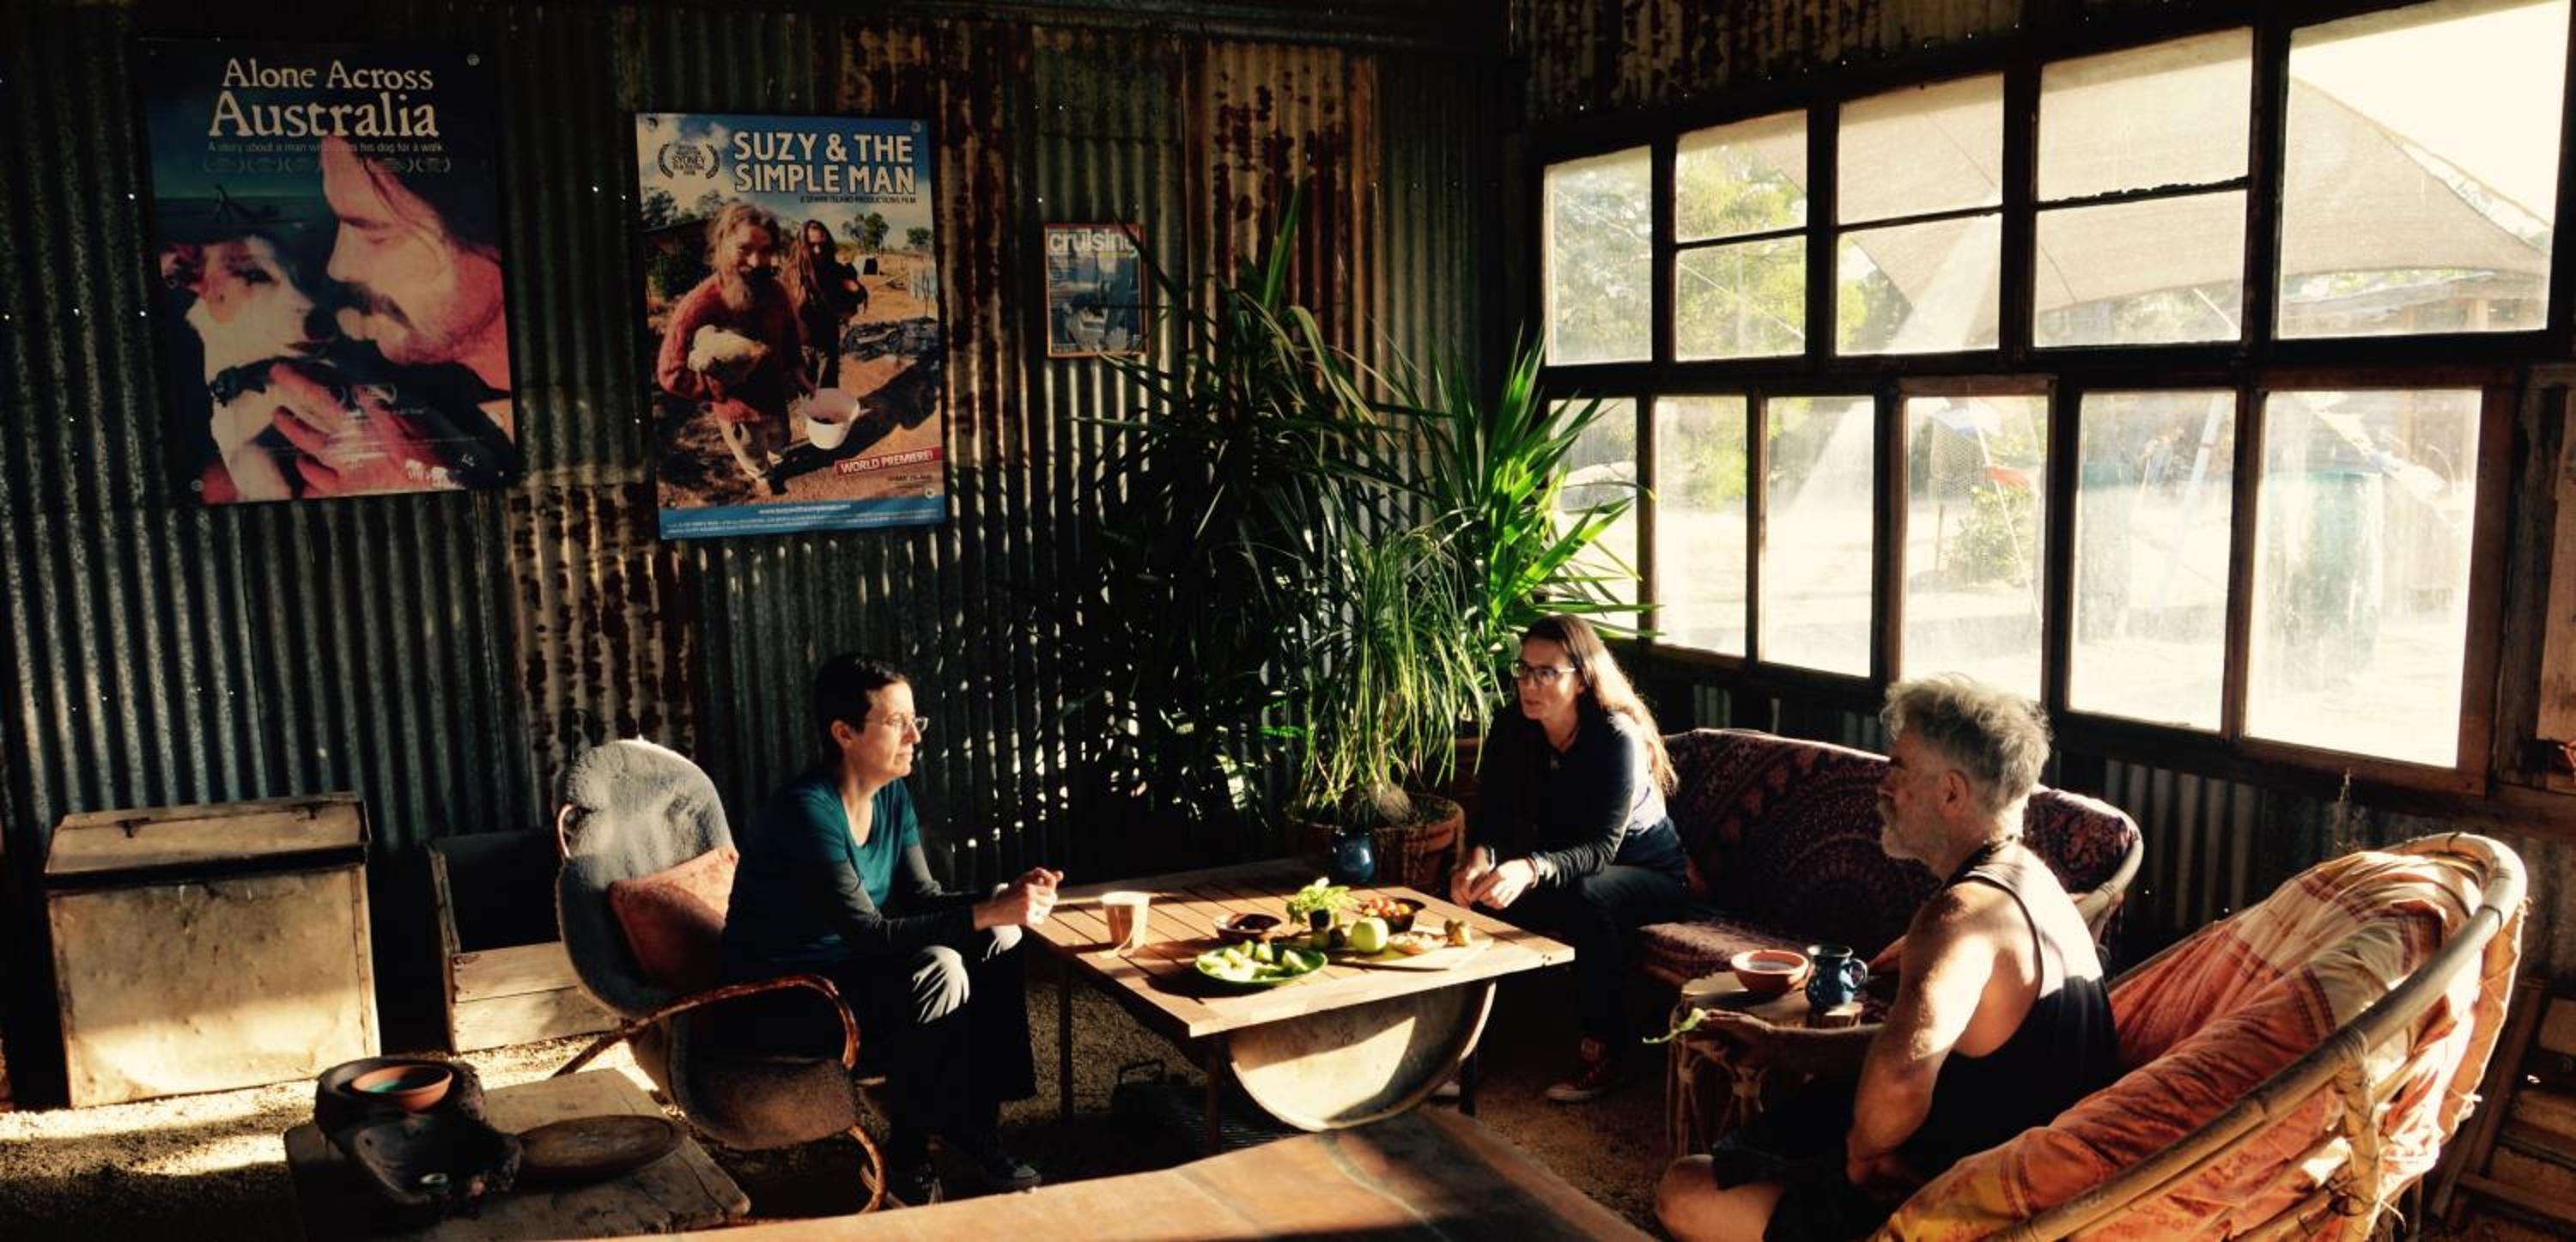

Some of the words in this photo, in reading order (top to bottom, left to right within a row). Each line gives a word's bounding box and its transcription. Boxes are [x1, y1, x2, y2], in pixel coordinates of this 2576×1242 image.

[222, 57, 317, 88] Alone
[325, 59, 434, 90] Across
[209, 91, 439, 139] Australia
[208, 142, 216, 151] A
[246, 142, 273, 151] about
[377, 142, 395, 154] dog
[421, 142, 443, 152] walk
[733, 131, 818, 162] SUZY
[825, 133, 848, 163] &
[853, 134, 914, 163] THE
[734, 163, 841, 193] SIMPLE
[848, 165, 916, 194] MAN
[841, 458, 880, 474] WORLD
